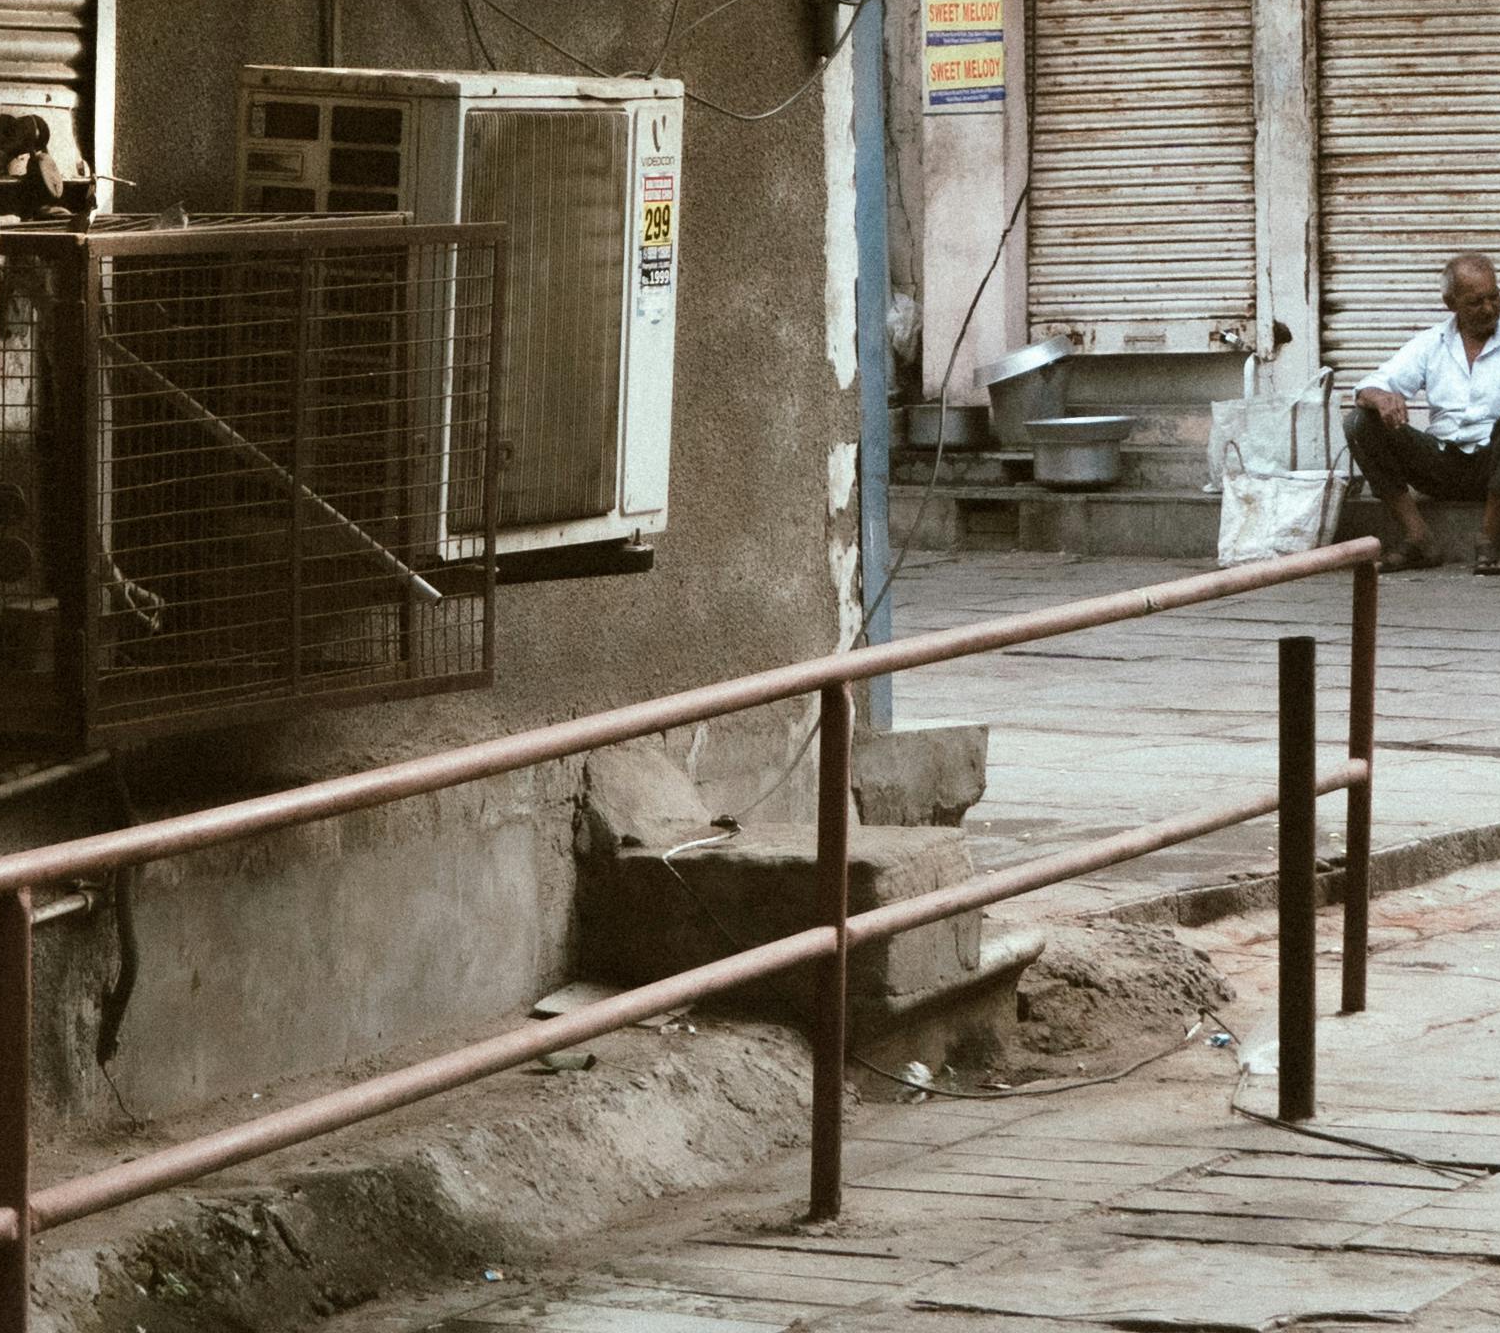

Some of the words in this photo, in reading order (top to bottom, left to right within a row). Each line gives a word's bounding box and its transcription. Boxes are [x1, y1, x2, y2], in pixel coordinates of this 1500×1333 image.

[930, 3, 960, 23] SWEET
[963, 1, 1000, 22] MELODY
[930, 61, 961, 82] SWEET
[964, 58, 1000, 79] MELODY
[640, 156, 675, 167] VIDEOCON
[645, 204, 670, 241] 299
